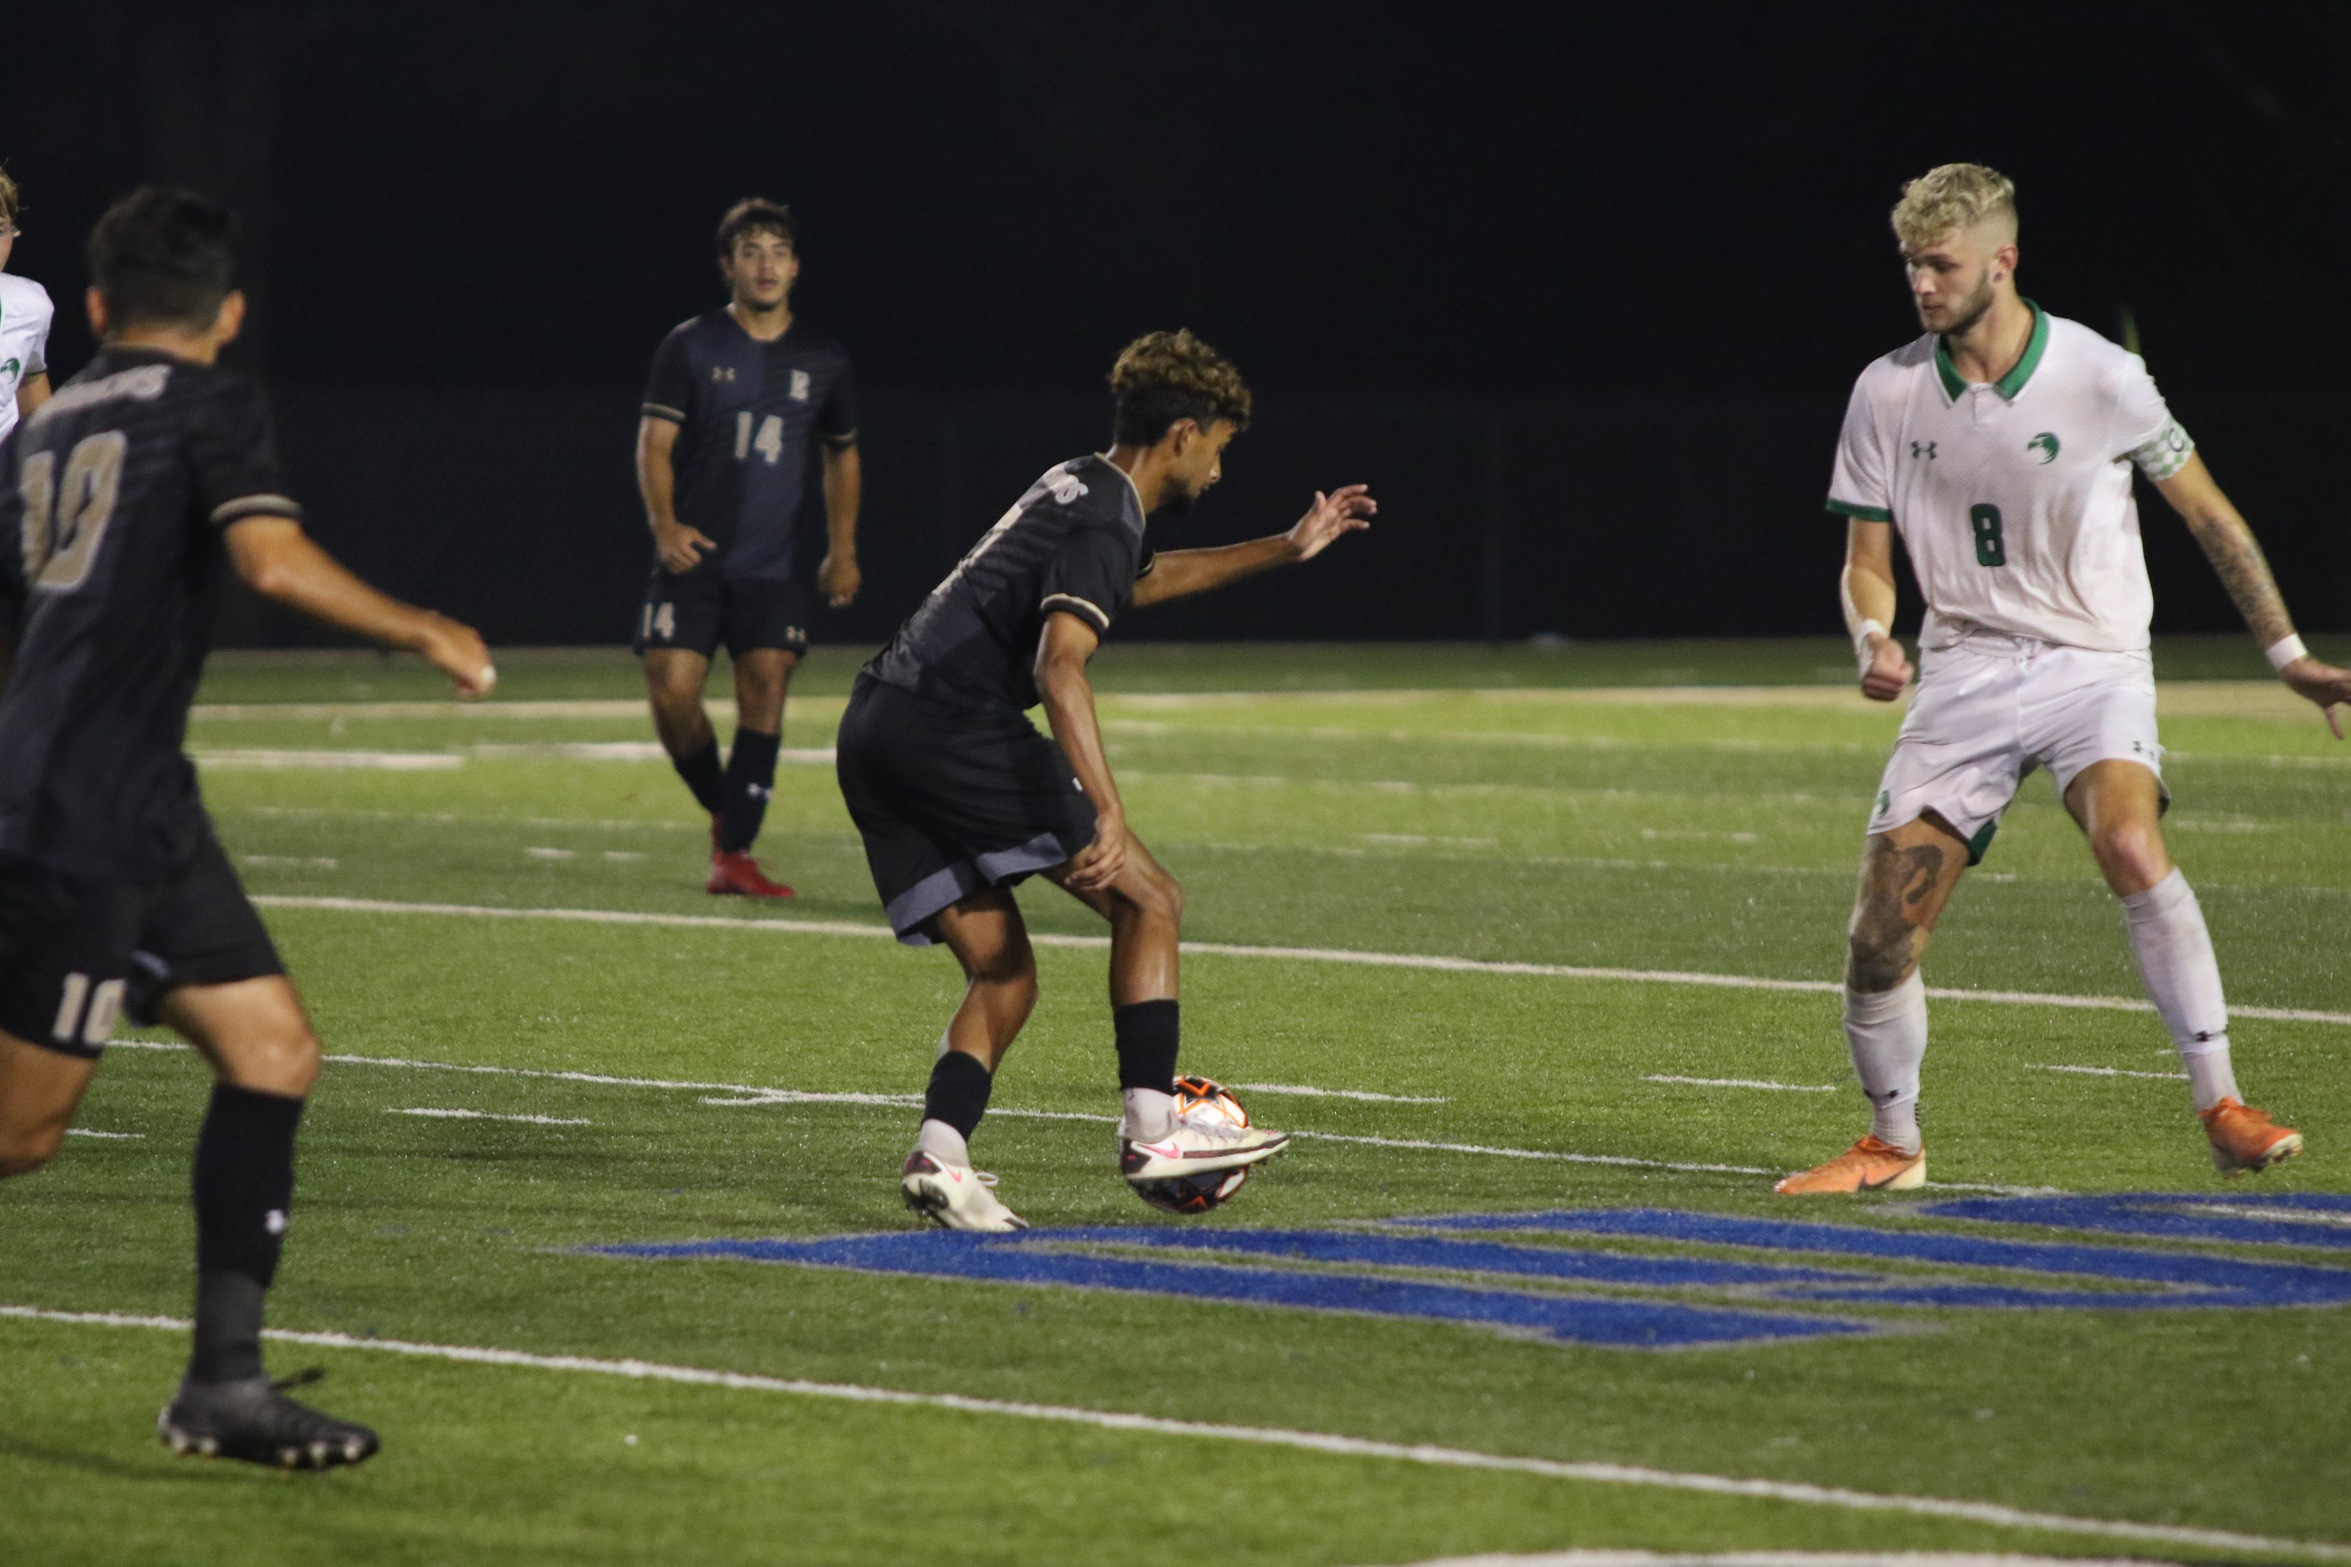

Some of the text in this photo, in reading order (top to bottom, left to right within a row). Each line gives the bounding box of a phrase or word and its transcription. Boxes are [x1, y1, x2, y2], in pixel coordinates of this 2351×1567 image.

[735, 410, 784, 465] 14
[18, 430, 128, 593] 10
[1970, 503, 2006, 567] 8
[641, 602, 674, 641] 14
